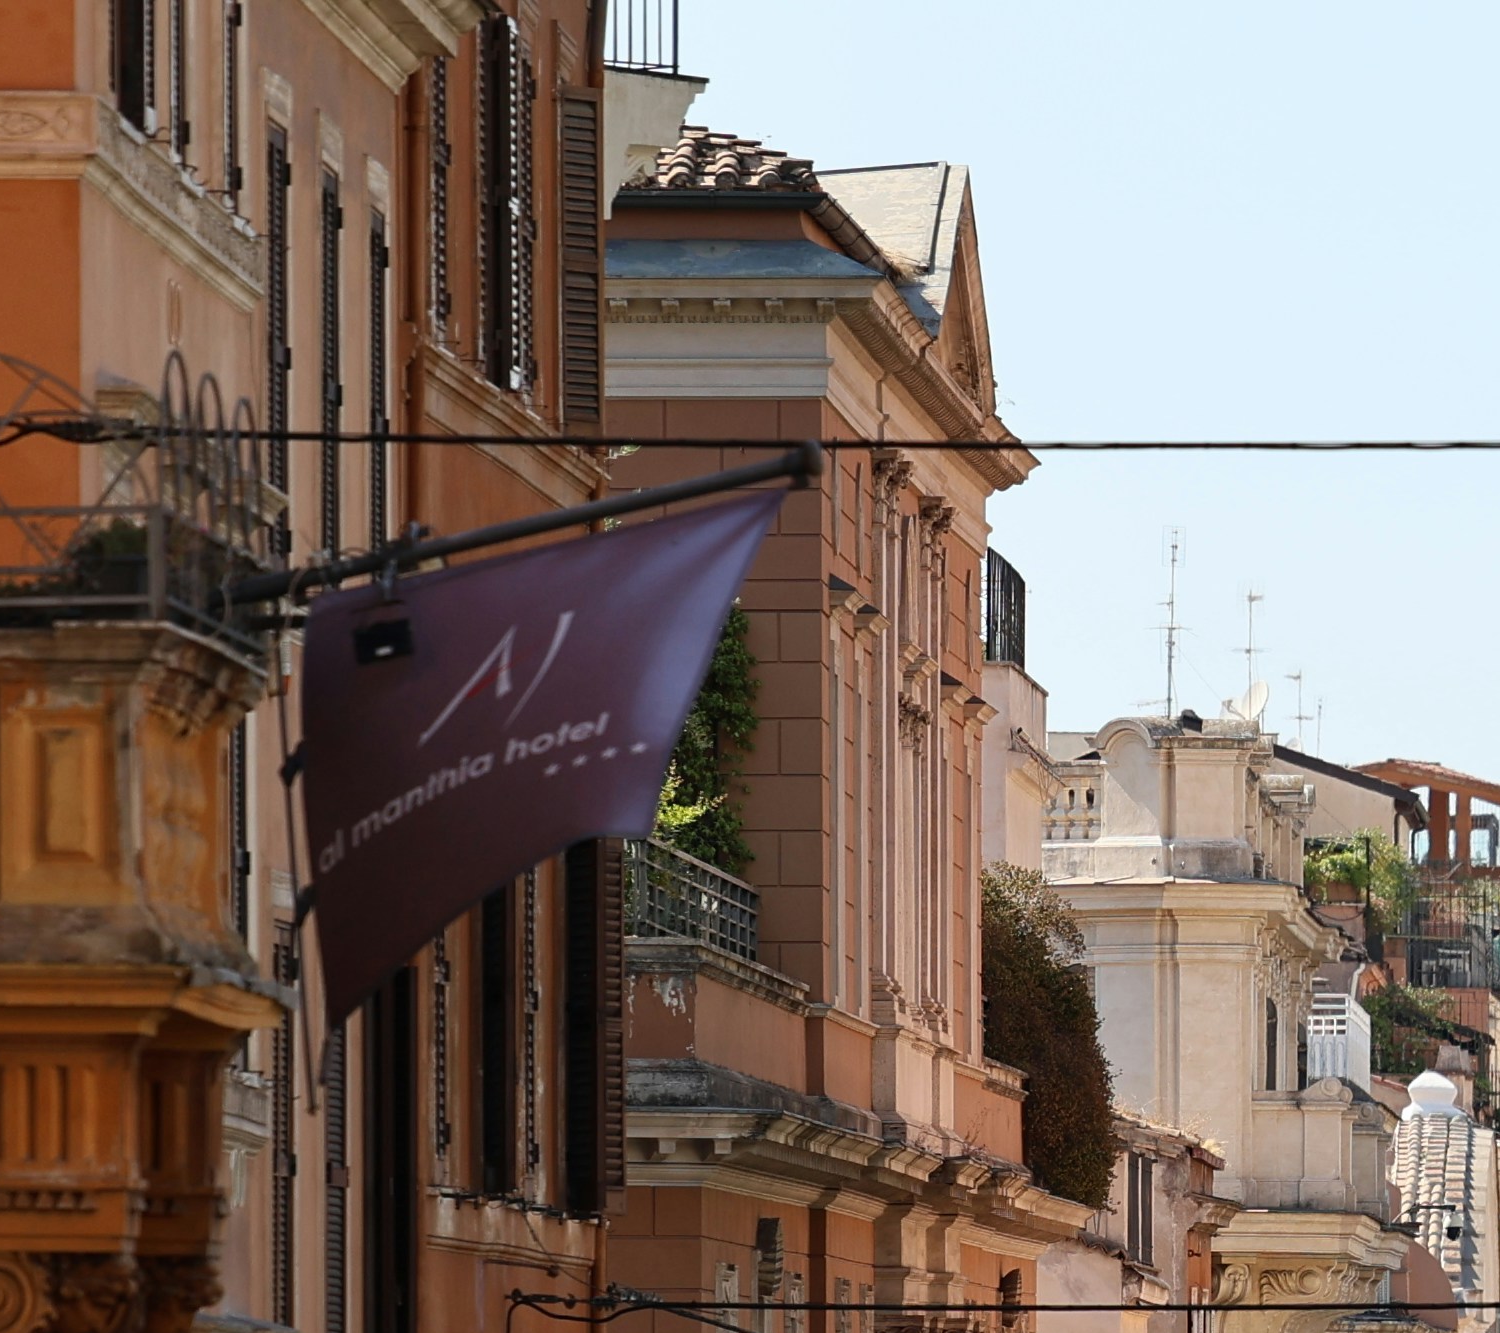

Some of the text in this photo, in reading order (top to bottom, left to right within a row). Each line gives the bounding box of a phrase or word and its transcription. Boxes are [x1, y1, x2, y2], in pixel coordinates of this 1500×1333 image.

[318, 711, 609, 873] al manthia hotel
